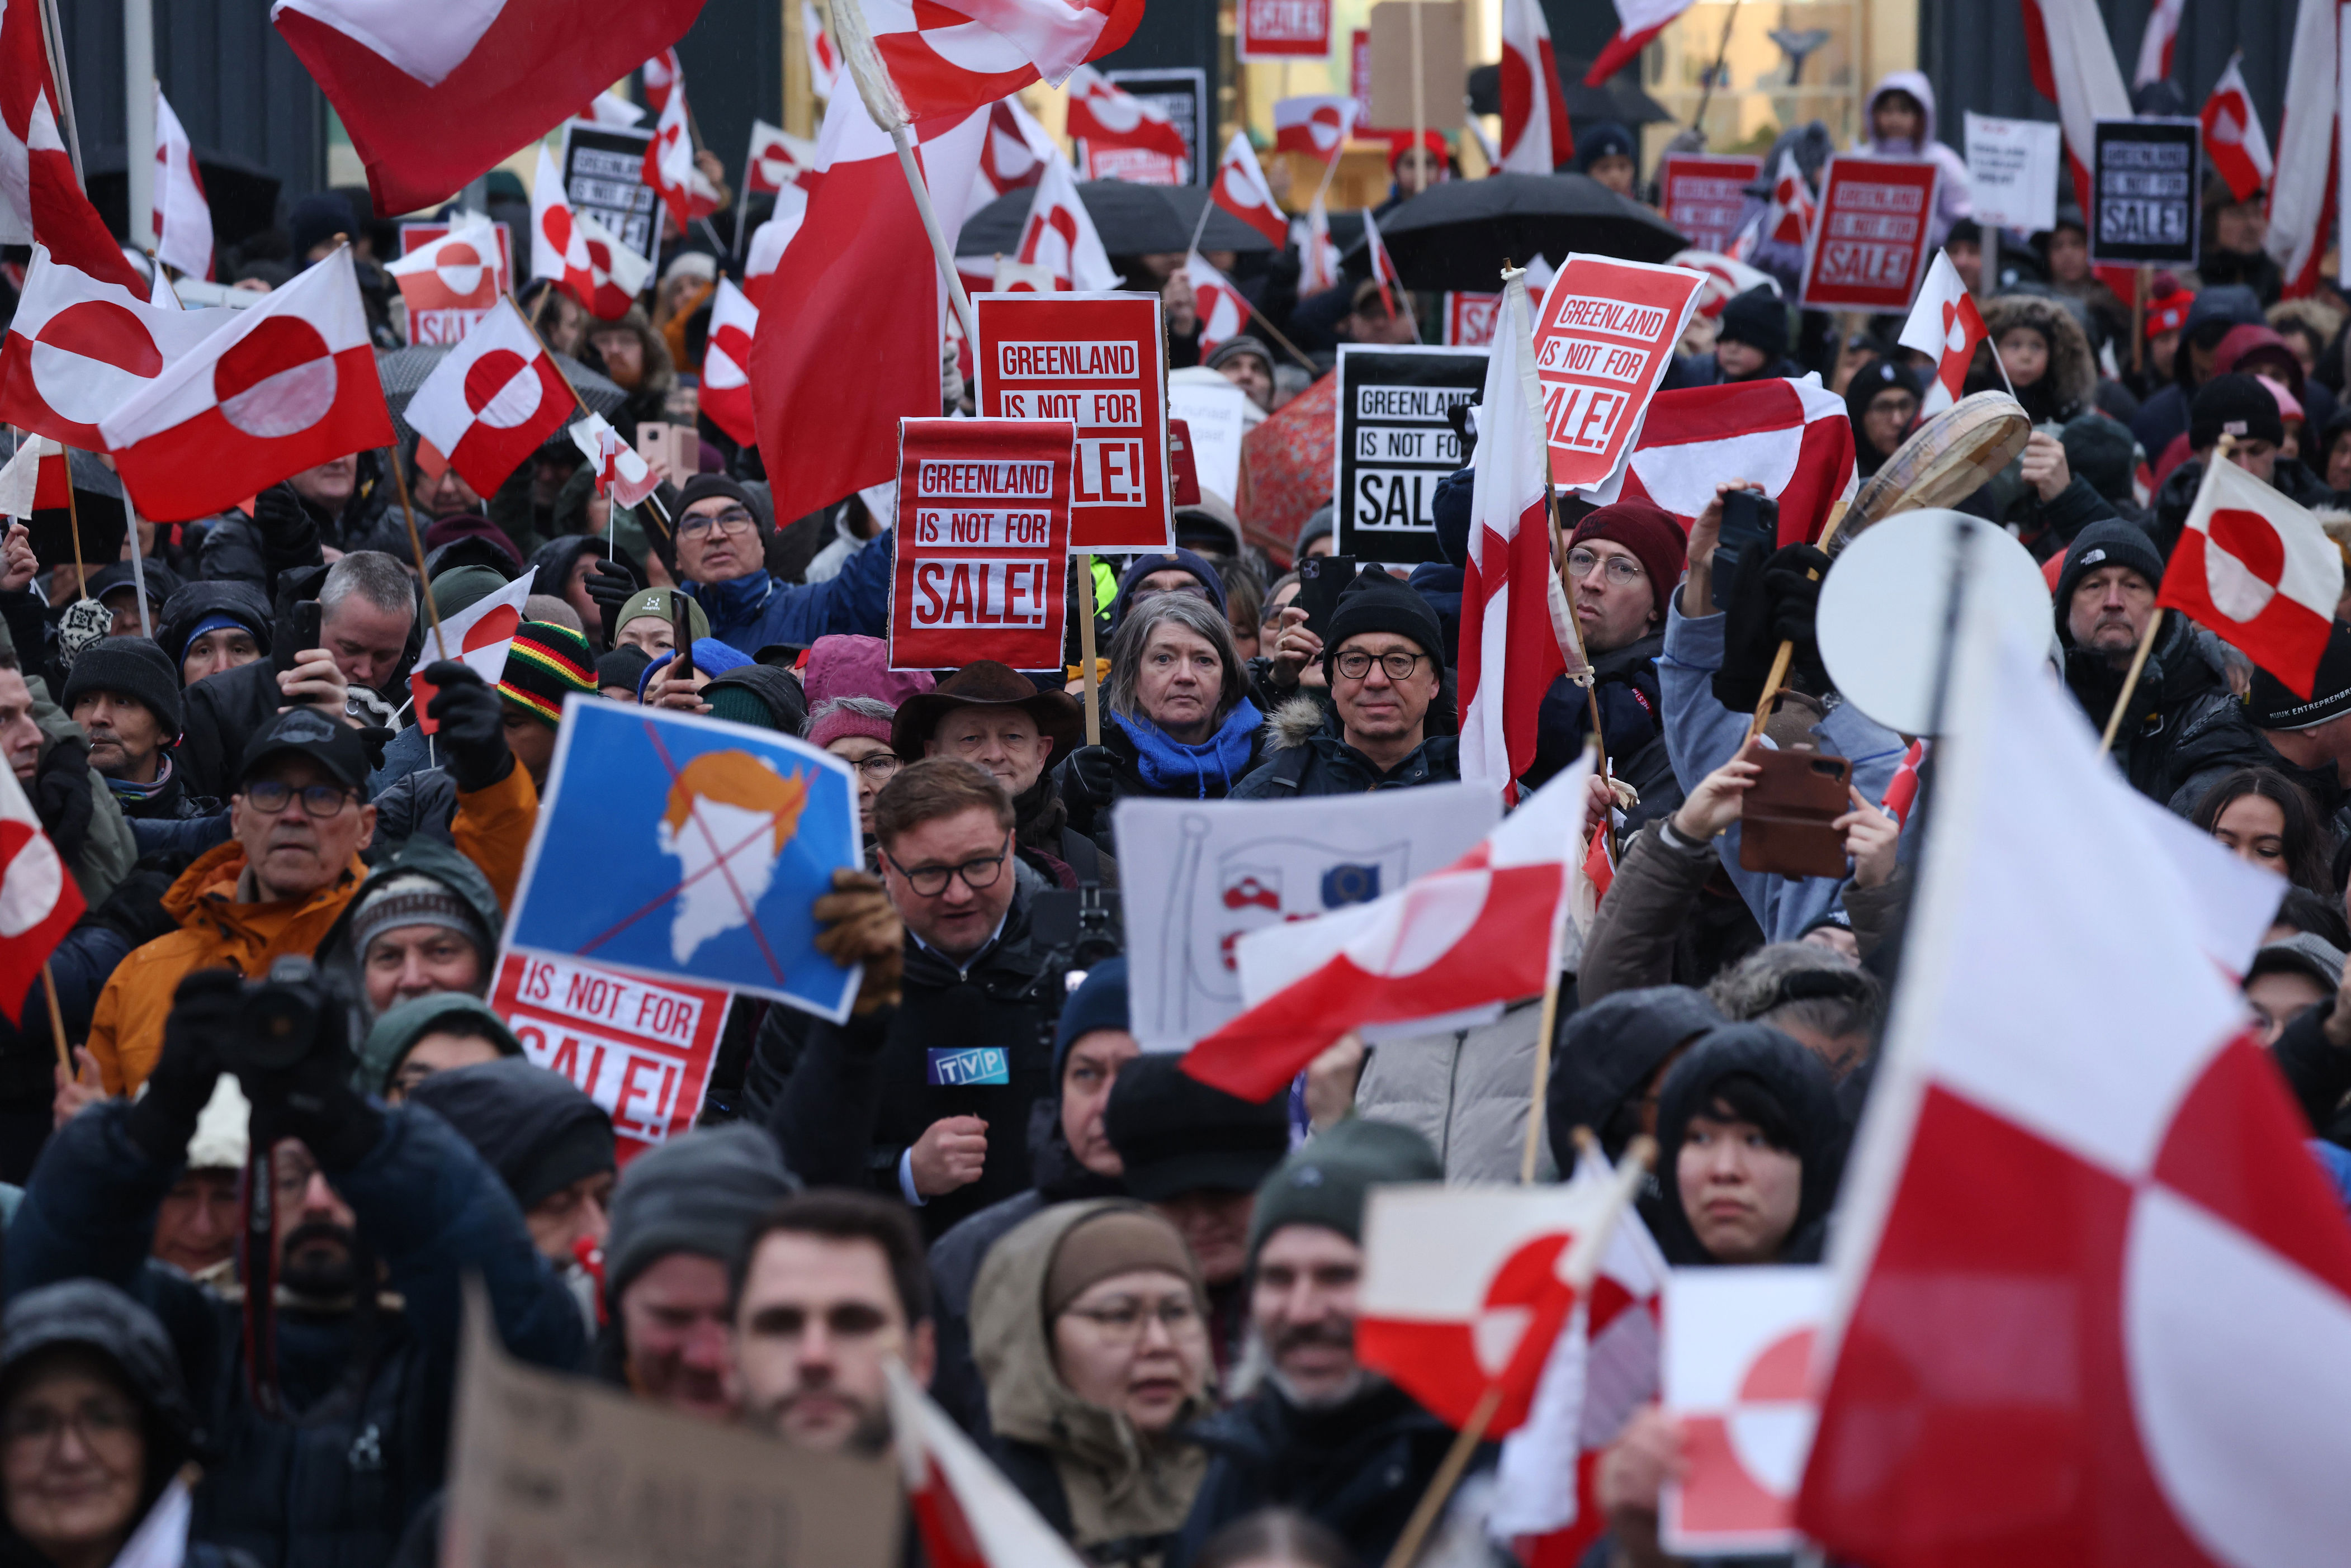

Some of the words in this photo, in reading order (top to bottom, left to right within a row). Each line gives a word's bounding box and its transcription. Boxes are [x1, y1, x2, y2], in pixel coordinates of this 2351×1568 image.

[1824, 245, 1909, 282] SALE!
[1560, 299, 1663, 337] GREENLAND
[1002, 345, 1134, 375] GREENLAND
[1539, 340, 1560, 366] IS
[1562, 343, 1603, 371] NOT
[1602, 349, 1643, 379] FOR
[1005, 395, 1025, 418] IS
[1038, 395, 1081, 423] NOT
[1094, 394, 1137, 423] FOR
[1542, 385, 1625, 449] ALE!
[1361, 432, 1376, 456] IS
[1389, 433, 1425, 457] NOT
[1437, 434, 1462, 458] FO
[922, 464, 1049, 494] GREENLAND
[1073, 443, 1142, 503] LE!
[1360, 474, 1449, 526] SAL
[919, 513, 940, 542] IS
[951, 513, 995, 543] NOT
[1006, 514, 1046, 543] FOR
[916, 563, 1044, 624] SALE!
[2269, 709, 2291, 719] NUUK
[526, 960, 555, 1000] IS
[567, 973, 629, 1020] NOT
[636, 992, 693, 1039] FOR
[941, 1051, 999, 1082] TVP
